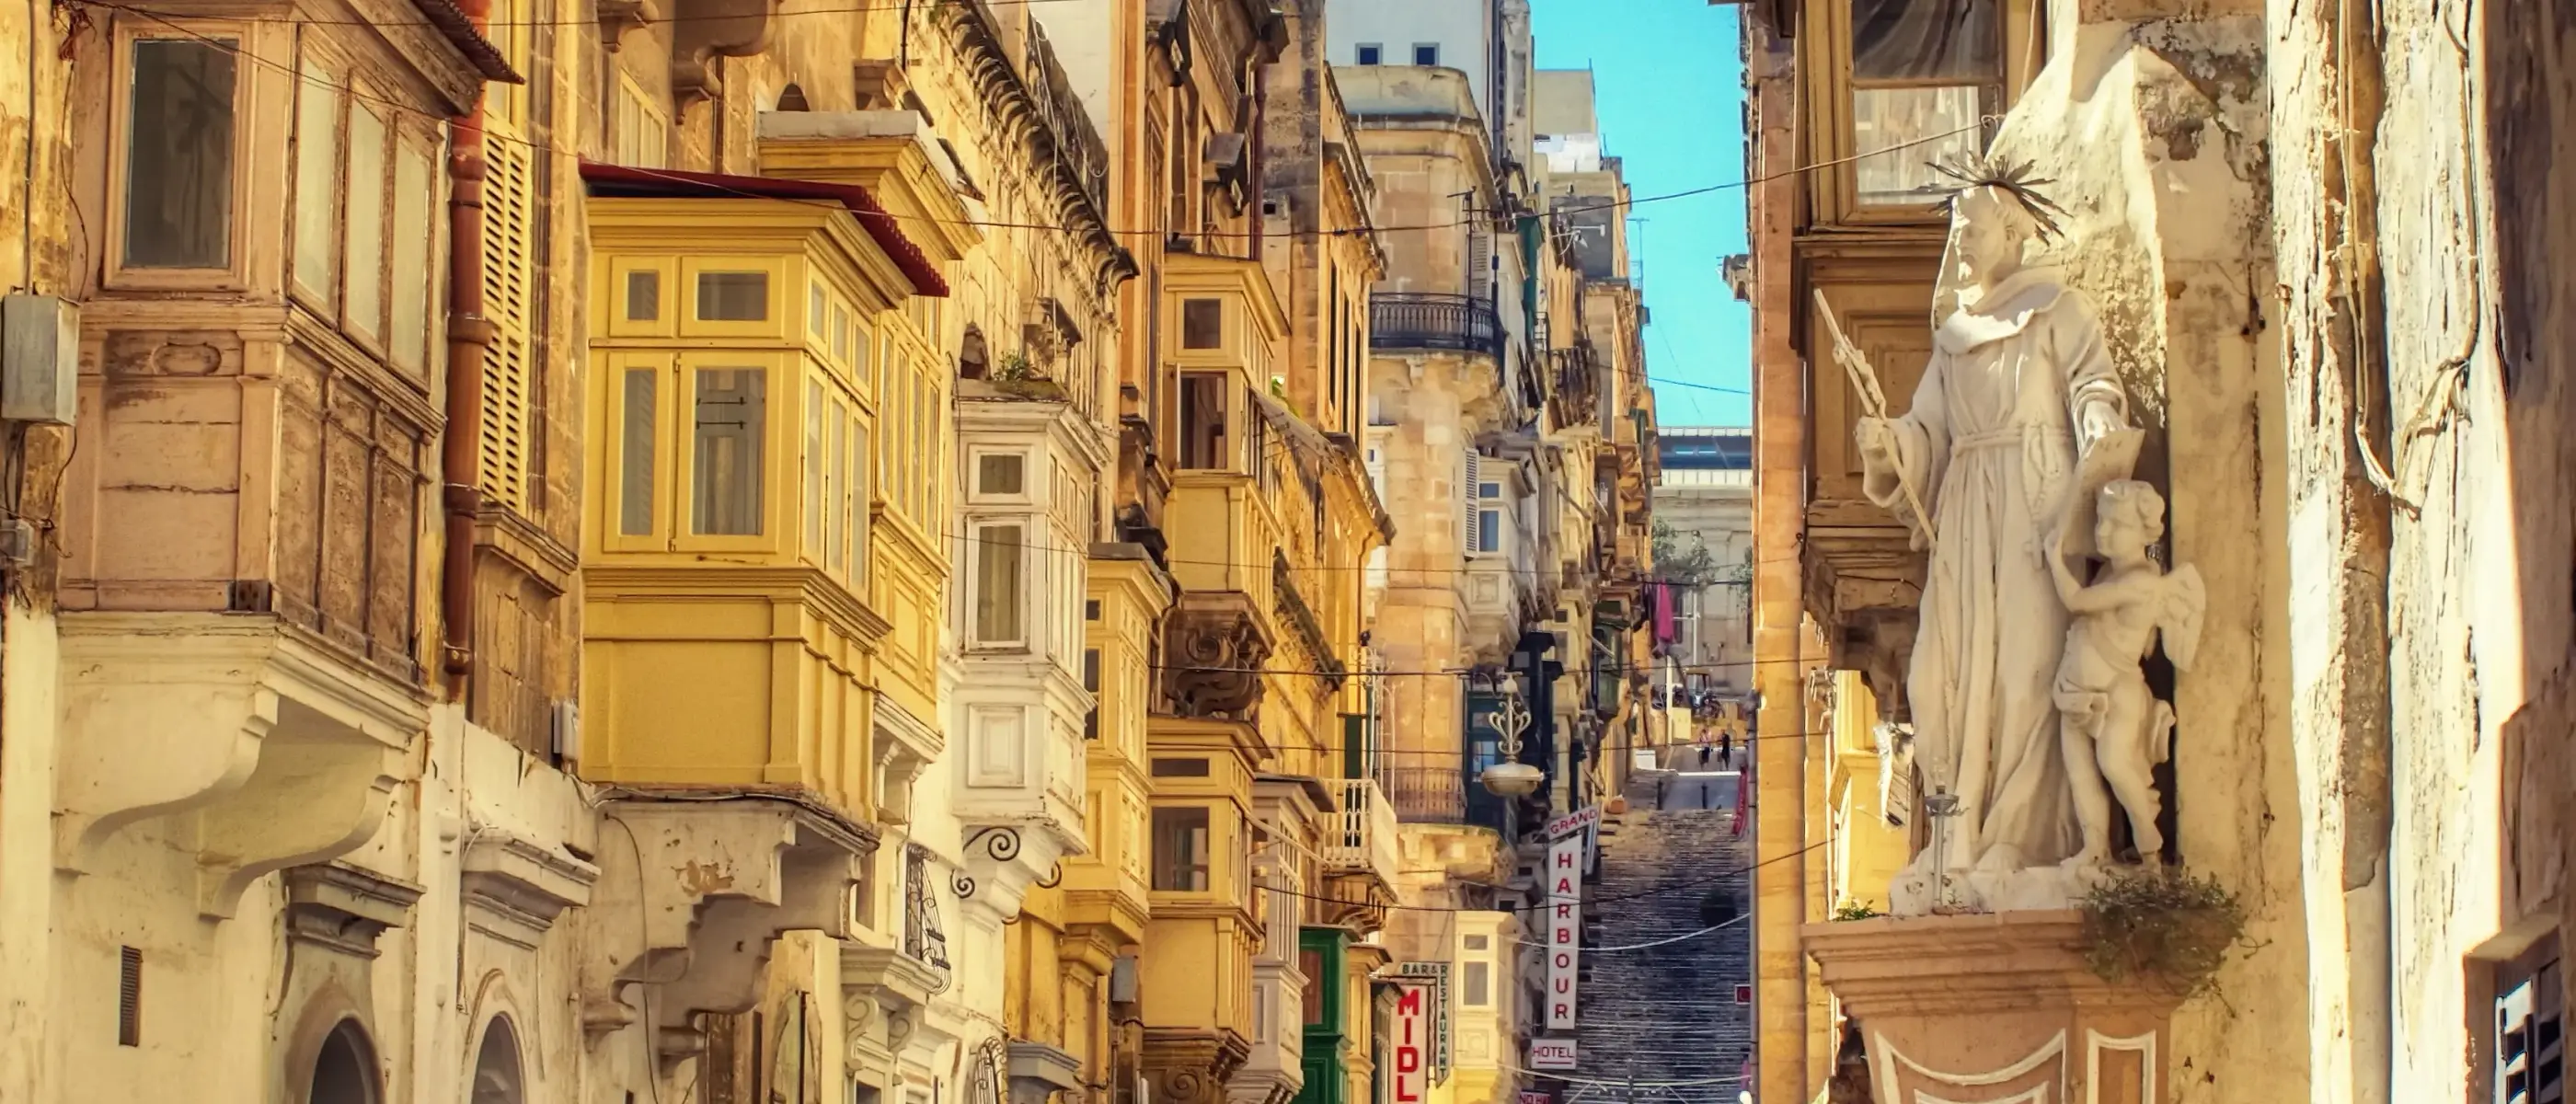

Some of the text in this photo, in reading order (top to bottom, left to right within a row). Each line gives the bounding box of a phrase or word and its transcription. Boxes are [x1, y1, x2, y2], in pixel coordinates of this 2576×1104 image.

[1550, 810, 1598, 834] GRAND
[1555, 853, 1572, 1019] HARBOUR
[1439, 964, 1448, 1078] RESTAURANT
[1533, 1046, 1575, 1058] HOTEL
